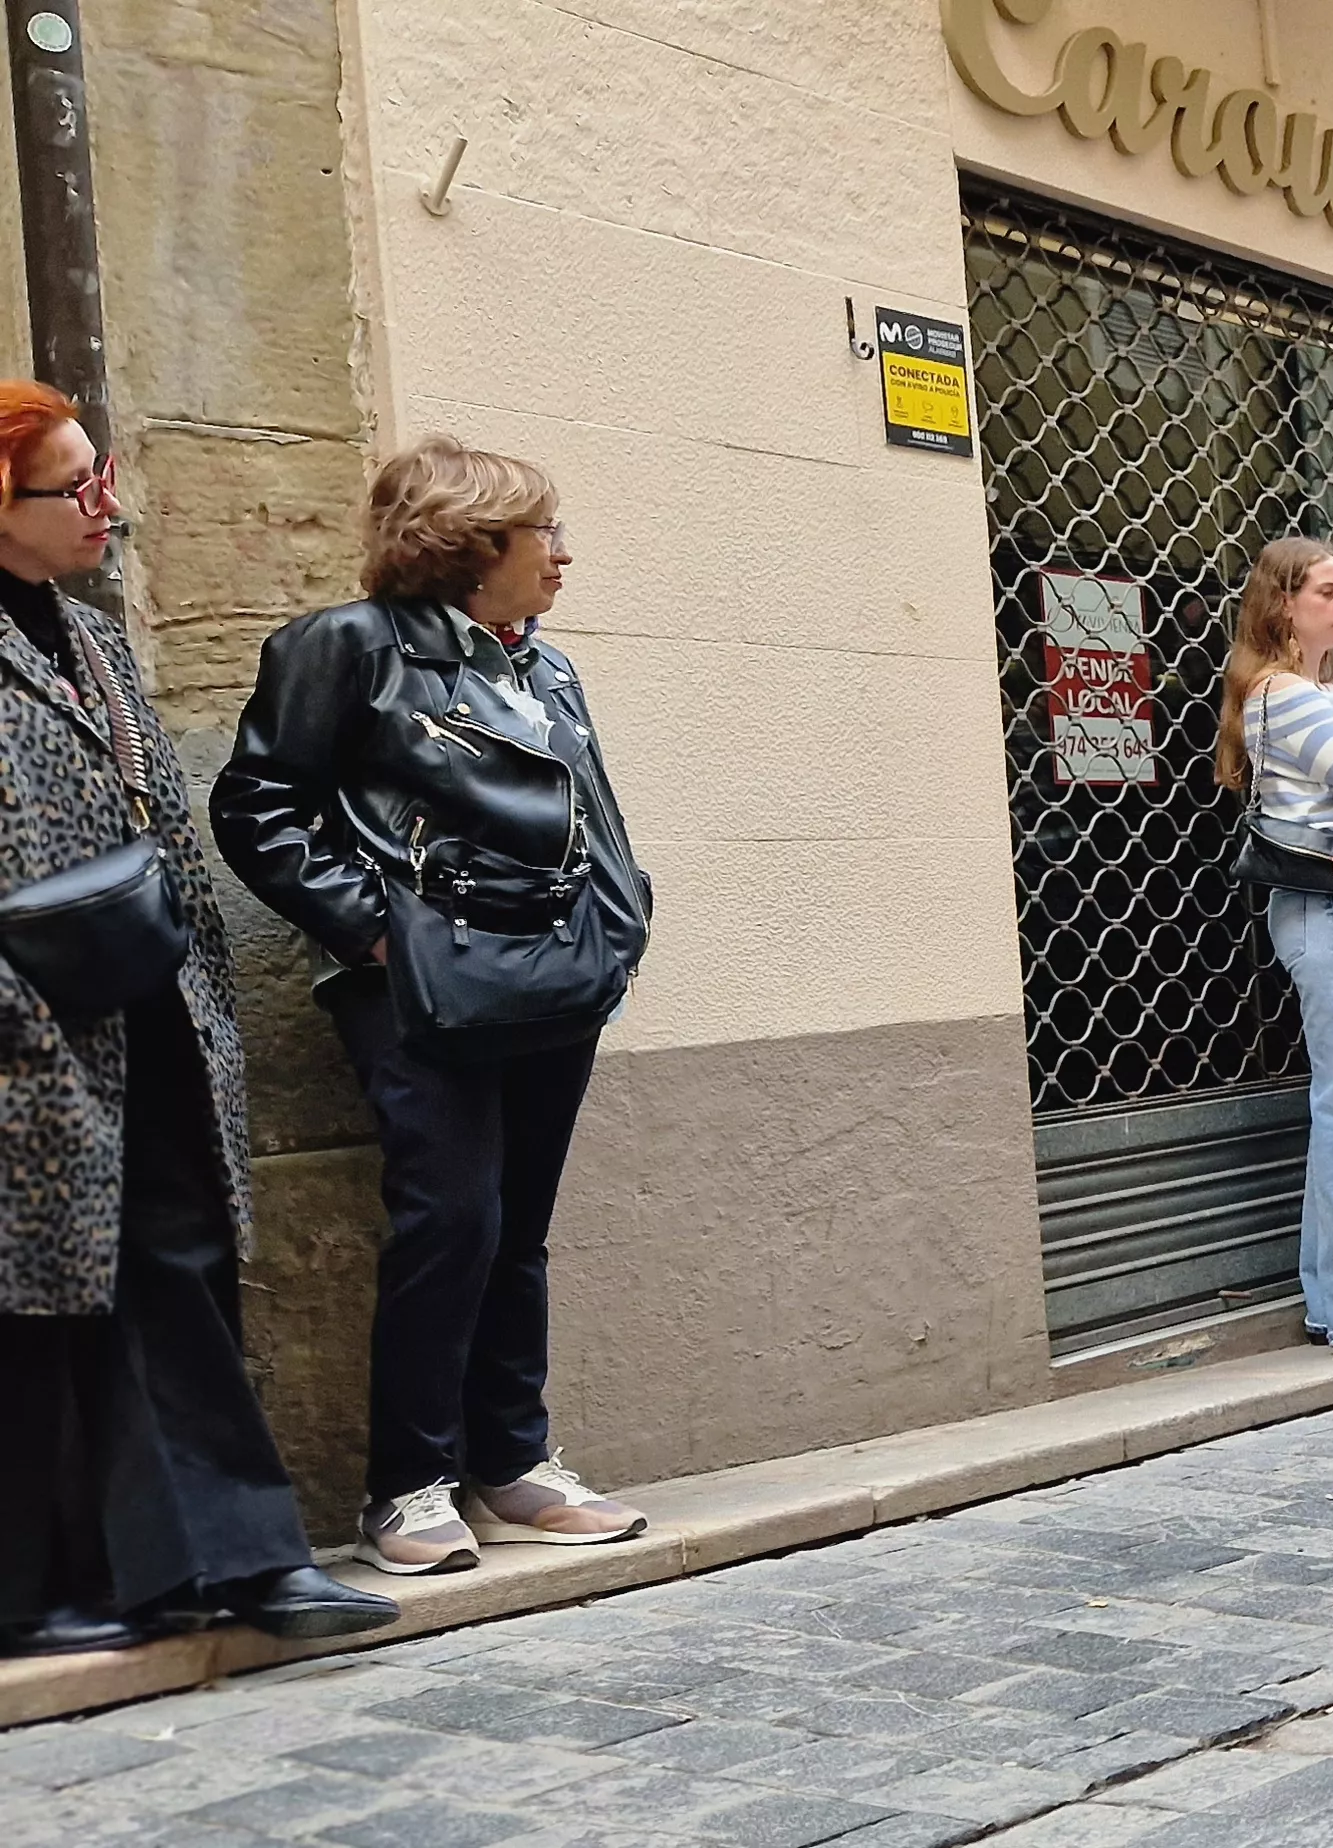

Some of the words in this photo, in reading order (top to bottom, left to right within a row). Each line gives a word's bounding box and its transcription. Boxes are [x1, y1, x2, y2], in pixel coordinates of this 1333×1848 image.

[889, 364, 960, 389] CONECTADA
[1060, 655, 1134, 683] VENDE
[1067, 688, 1132, 714] LOCAL
